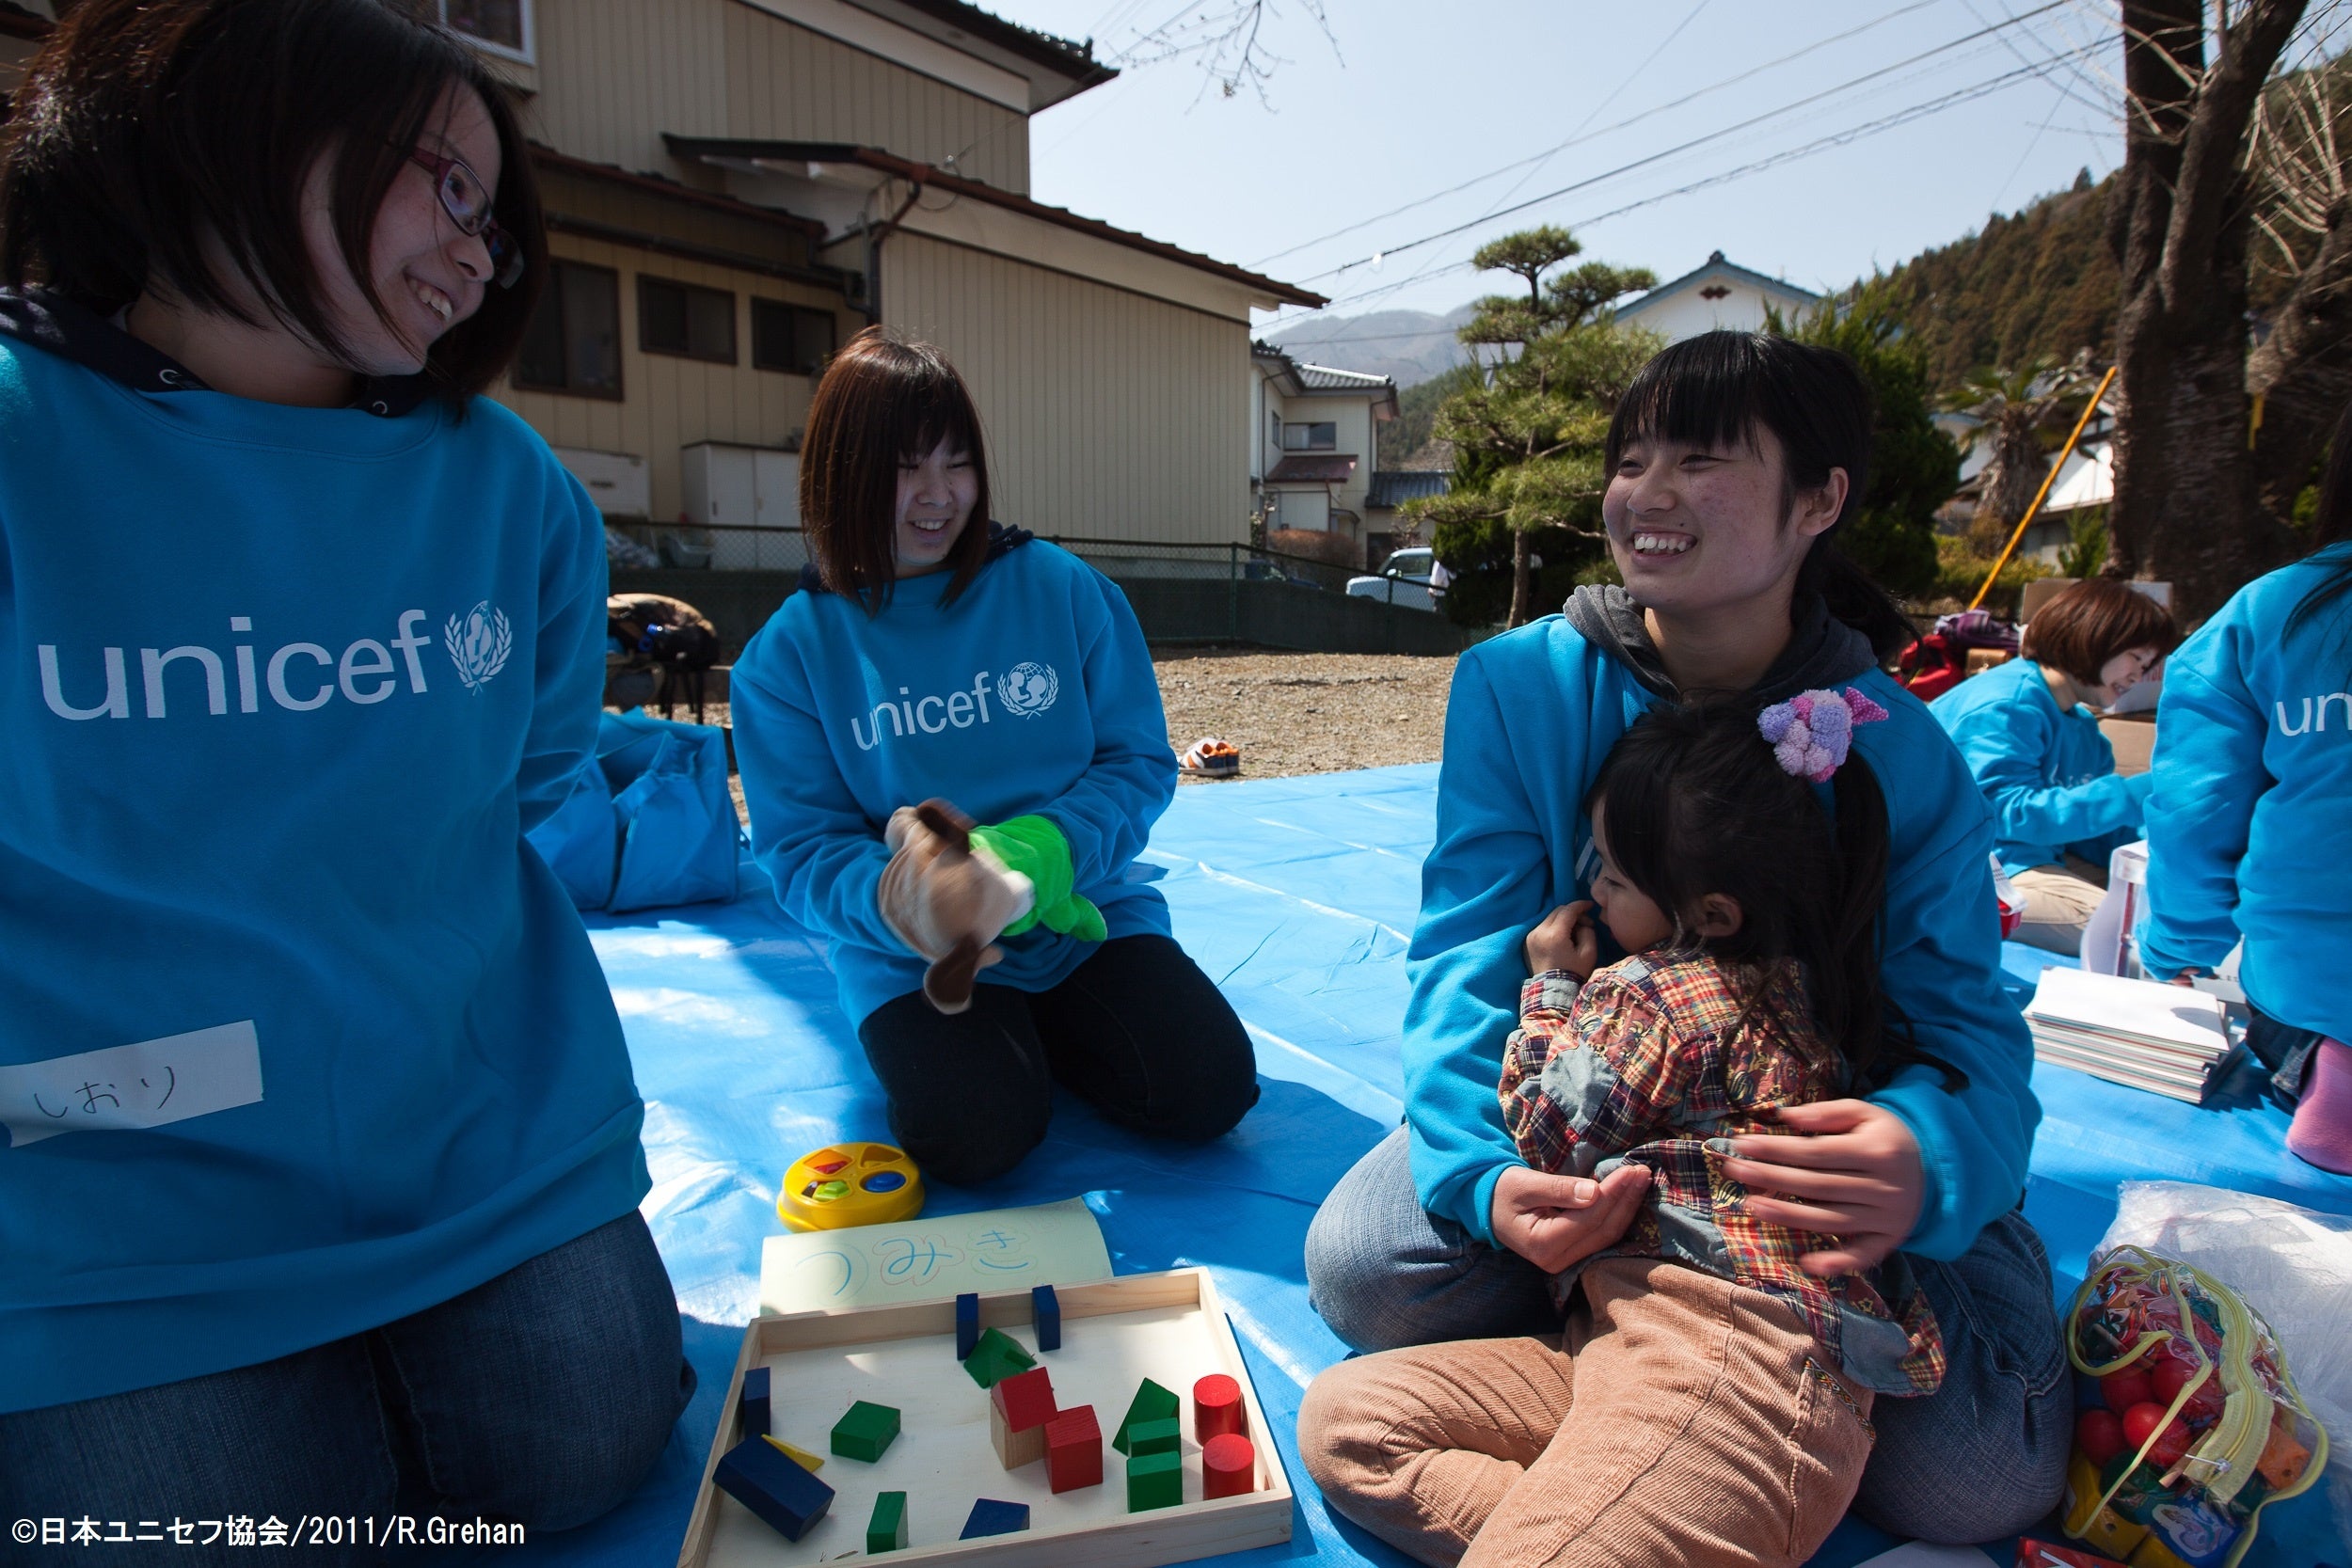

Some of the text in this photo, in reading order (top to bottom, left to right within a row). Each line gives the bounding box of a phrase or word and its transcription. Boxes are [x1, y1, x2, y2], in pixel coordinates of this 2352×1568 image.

[38, 610, 431, 721] unicef
[850, 671, 992, 751] unicef
[33, 1065, 176, 1119] しおり
[794, 1229, 1031, 1297] つみき
